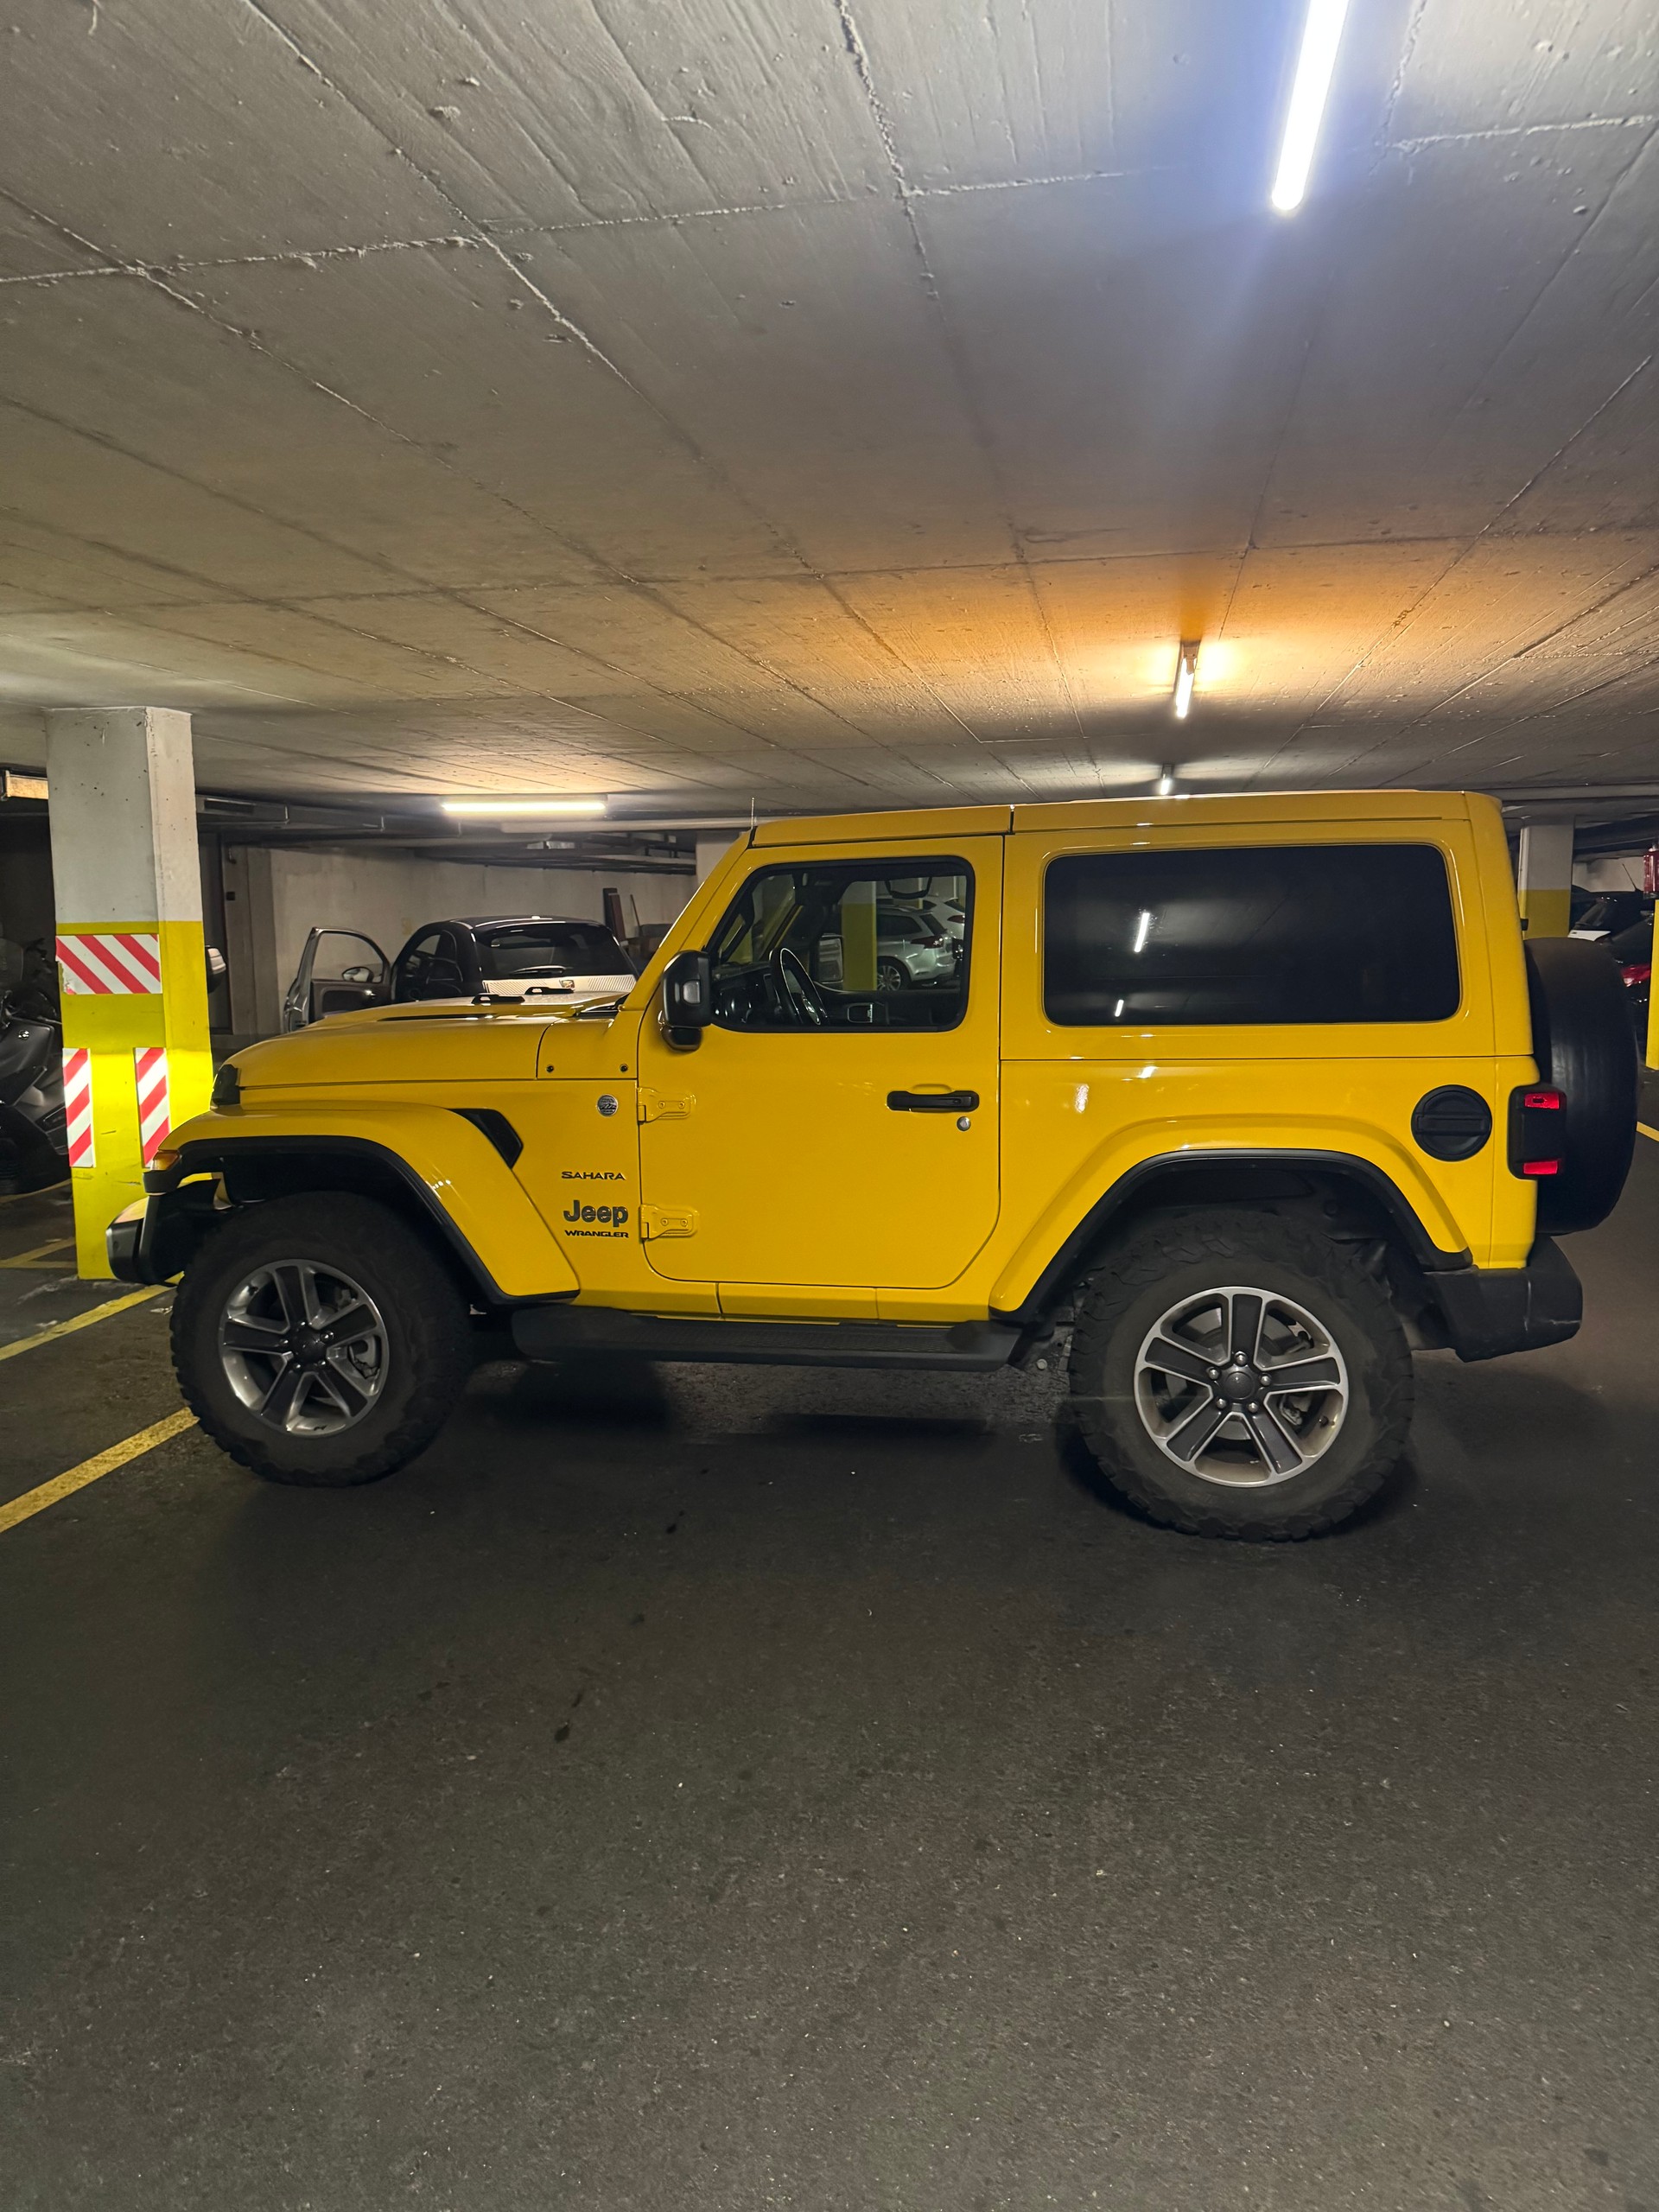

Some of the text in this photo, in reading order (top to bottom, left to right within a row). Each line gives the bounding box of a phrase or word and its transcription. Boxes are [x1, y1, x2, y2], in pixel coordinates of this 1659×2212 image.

[562, 1171, 626, 1180] SAHARA
[563, 1199, 629, 1228] Jeep
[564, 1230, 629, 1238] WRANGLER
